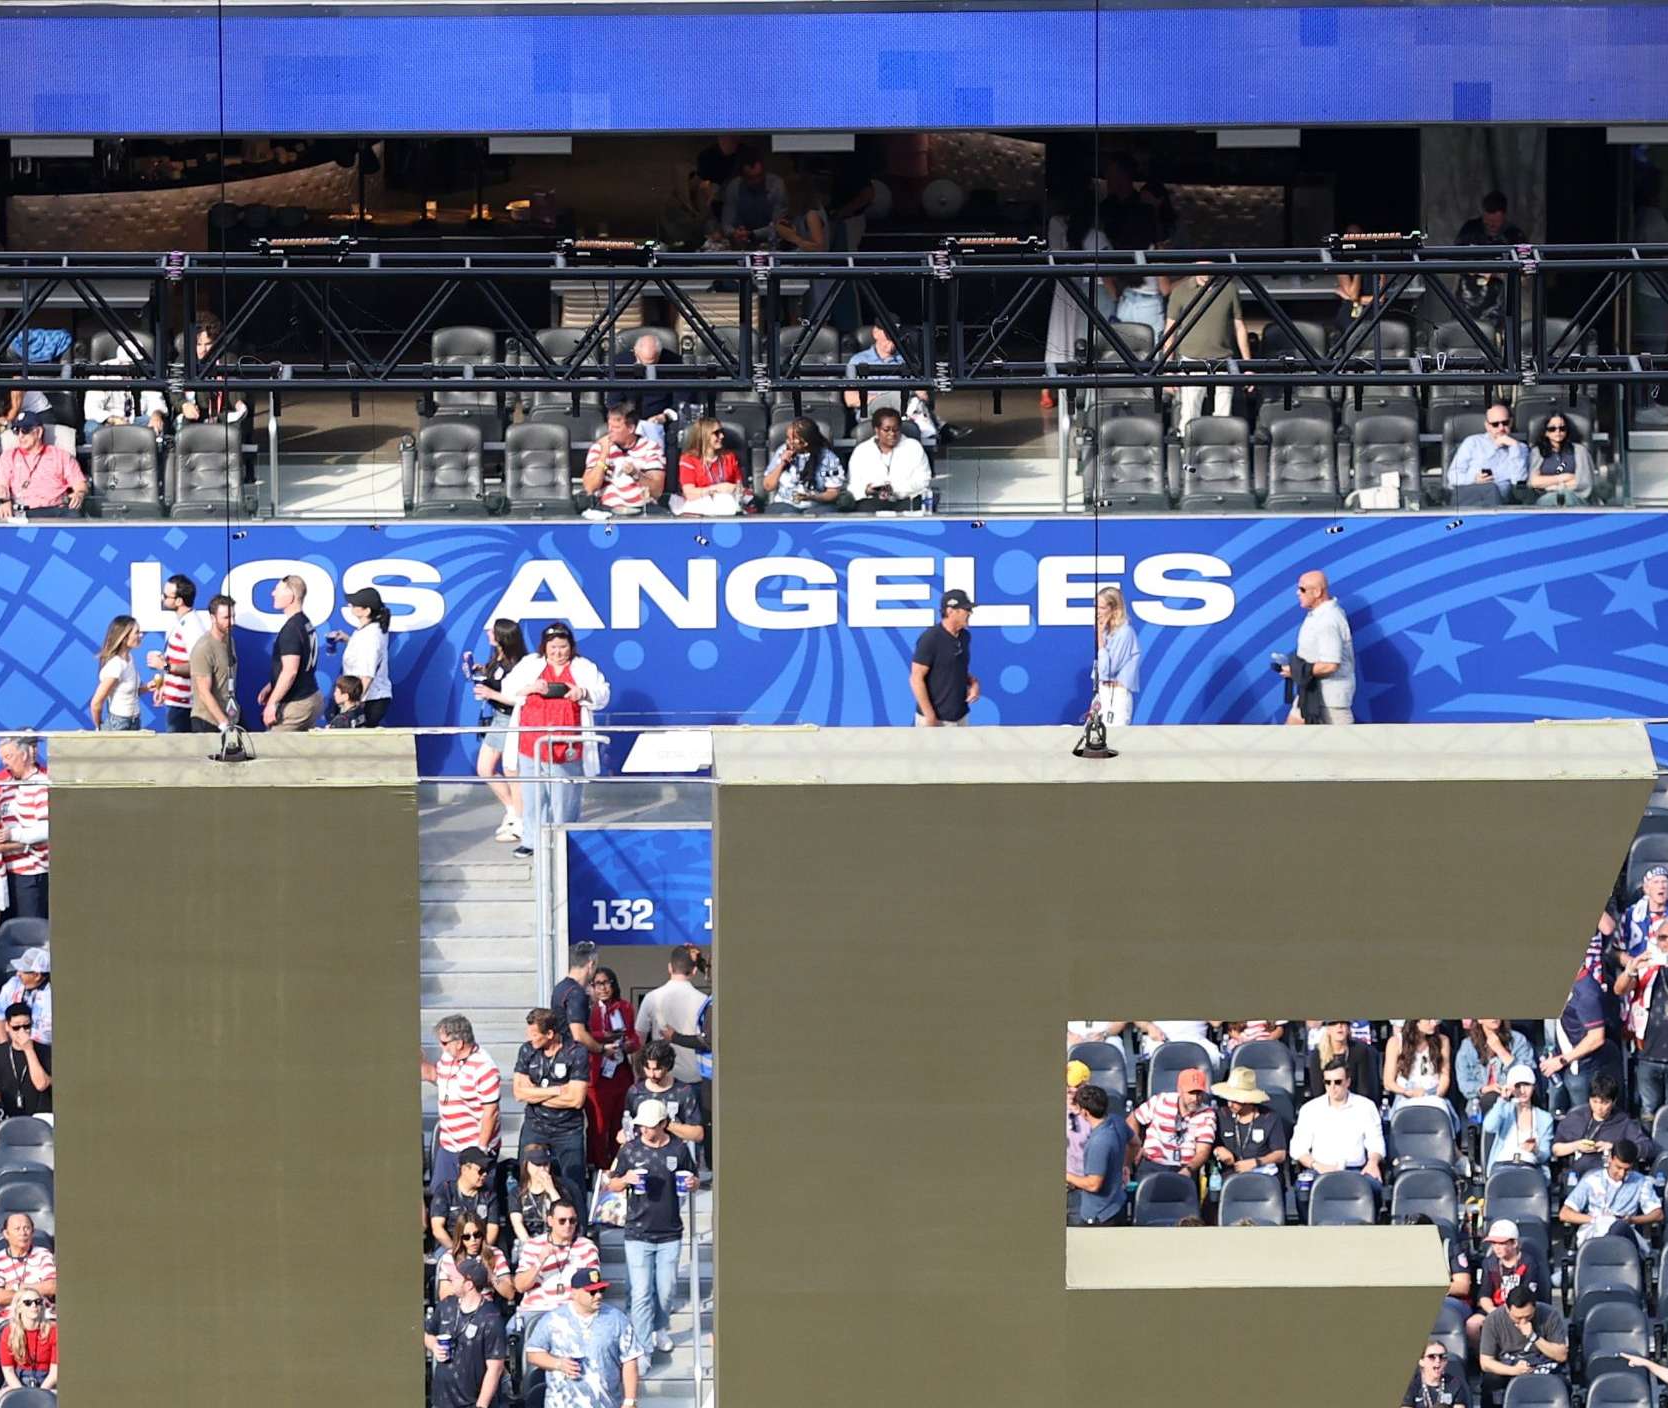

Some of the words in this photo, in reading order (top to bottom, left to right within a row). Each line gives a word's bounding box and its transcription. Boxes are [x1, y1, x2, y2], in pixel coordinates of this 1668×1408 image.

[130, 558, 444, 633] LOS
[483, 553, 1235, 632] ANGELES
[592, 899, 654, 931] 132
